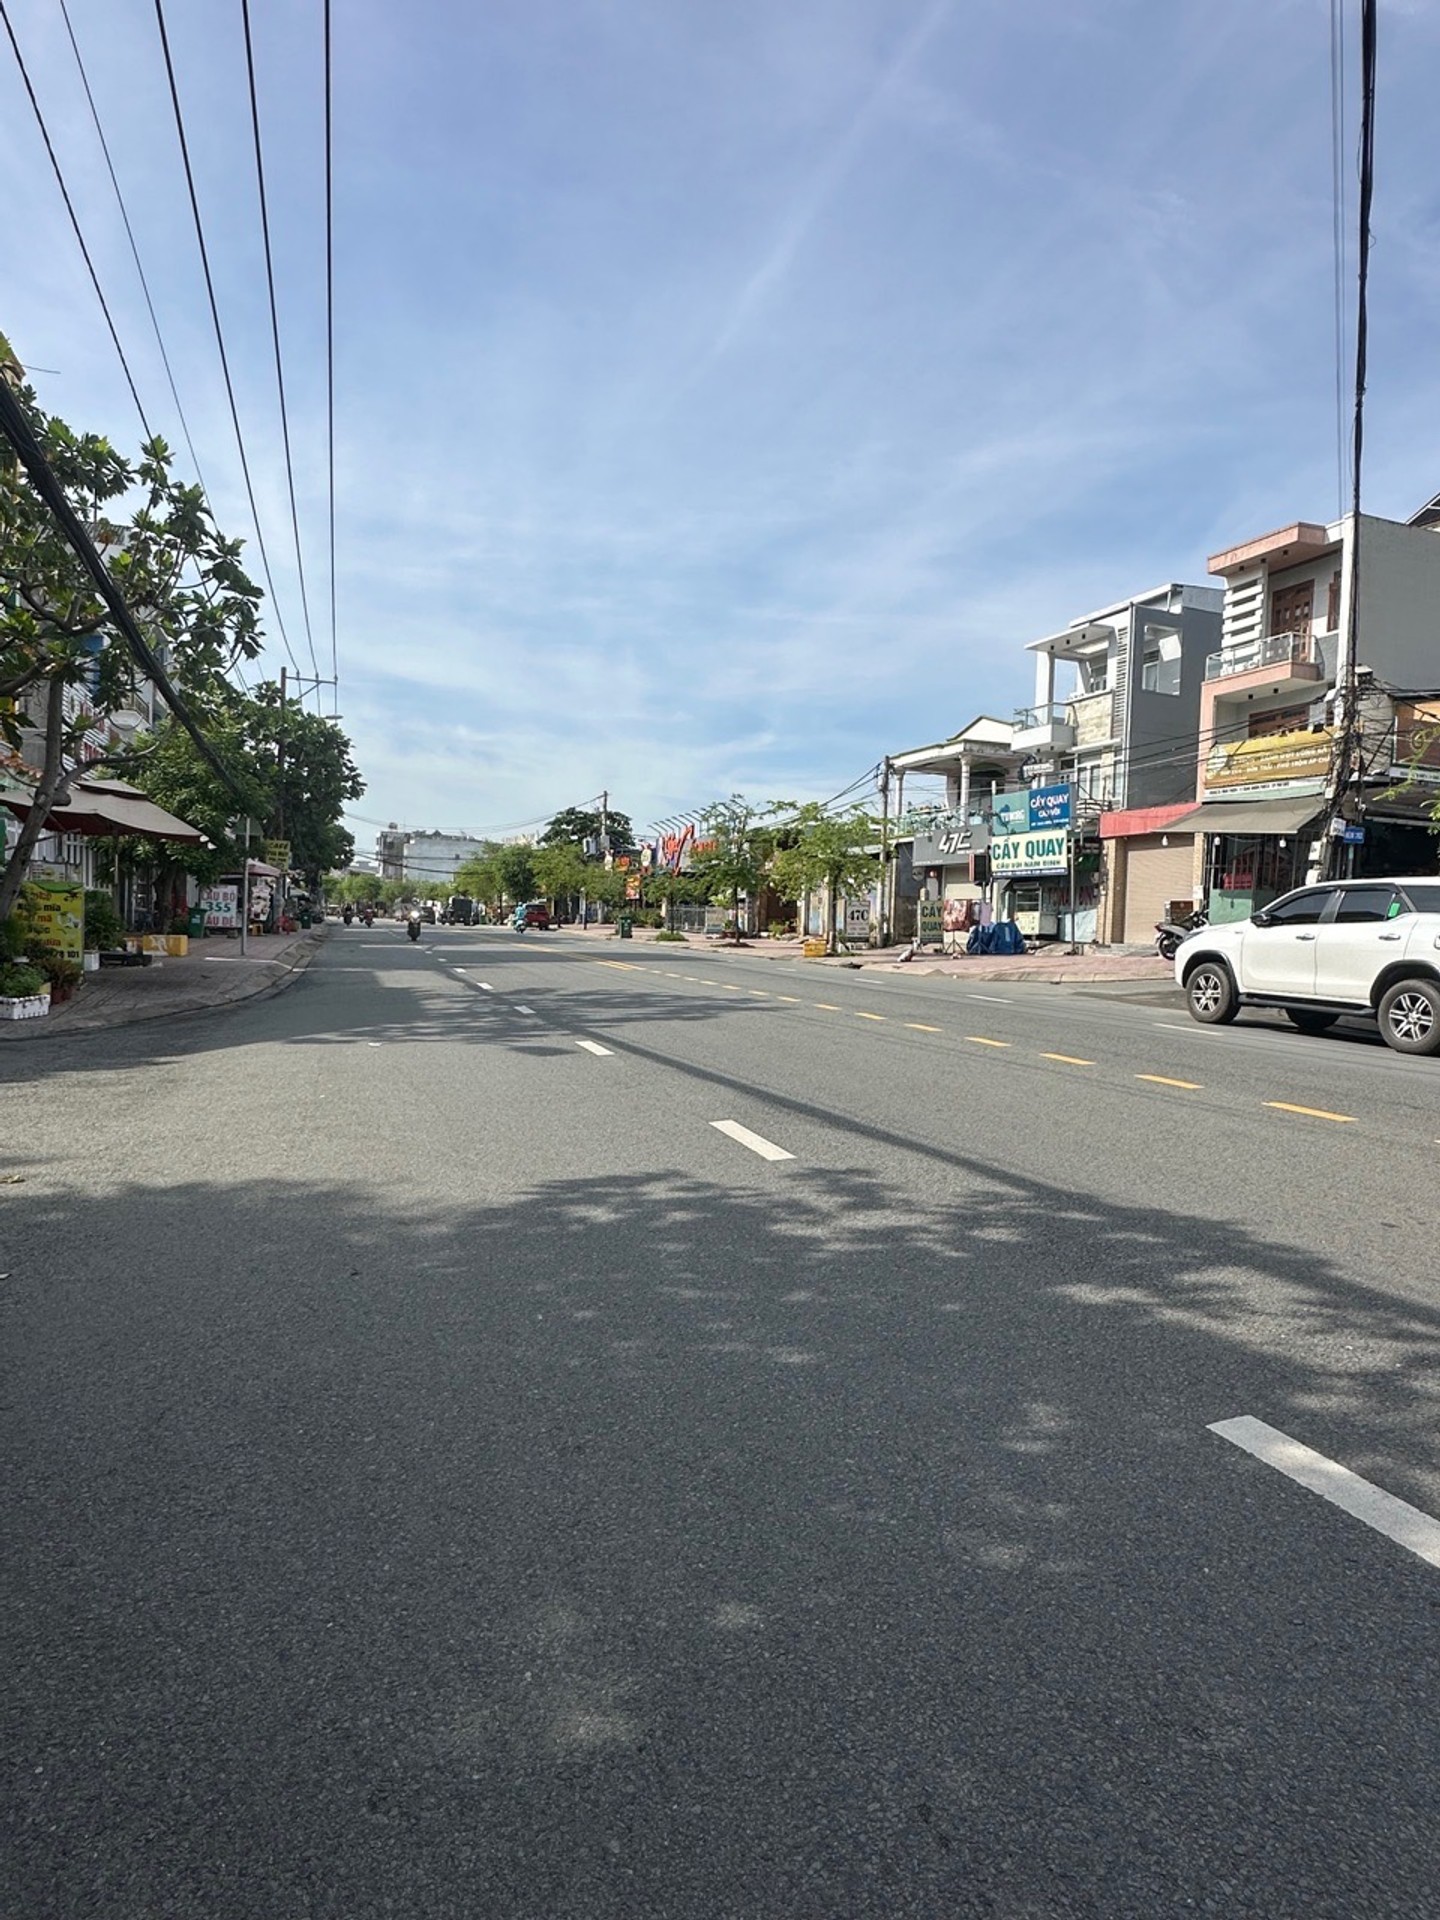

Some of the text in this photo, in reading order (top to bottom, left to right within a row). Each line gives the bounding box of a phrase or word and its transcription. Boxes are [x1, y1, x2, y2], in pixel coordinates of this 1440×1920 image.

[1046, 793, 1069, 807] QUAY
[1025, 837, 1065, 860] QUAY
[205, 901, 231, 913] 355
